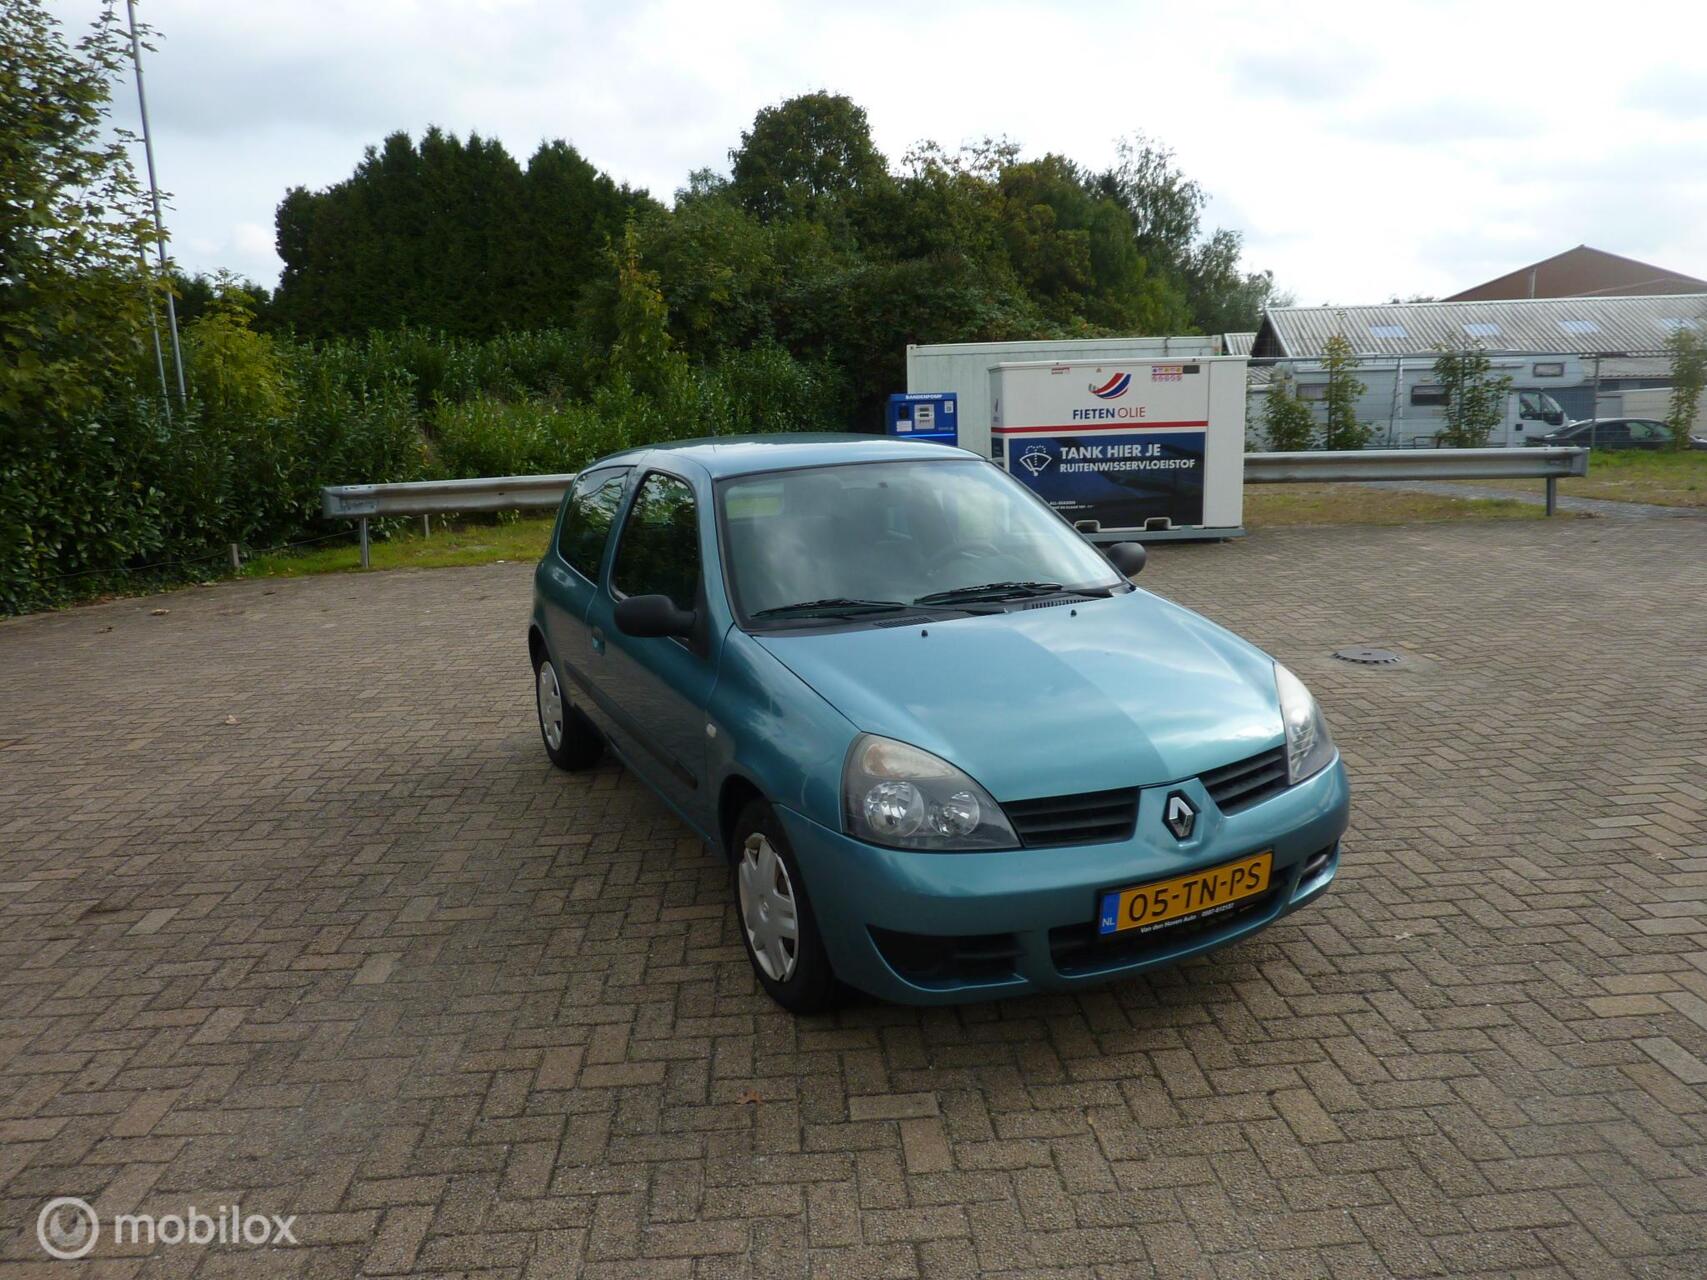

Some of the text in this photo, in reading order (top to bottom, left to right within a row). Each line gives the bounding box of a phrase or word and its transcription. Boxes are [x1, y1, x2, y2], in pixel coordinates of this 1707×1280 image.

[1072, 406, 1146, 420] FIETEN OLIE
[1060, 443, 1161, 460] TANK HIER JE
[1060, 458, 1196, 473] RUITENWISSERVLOEISTOF
[1128, 862, 1262, 922] 05-TN-PS
[1102, 917, 1115, 927] NL
